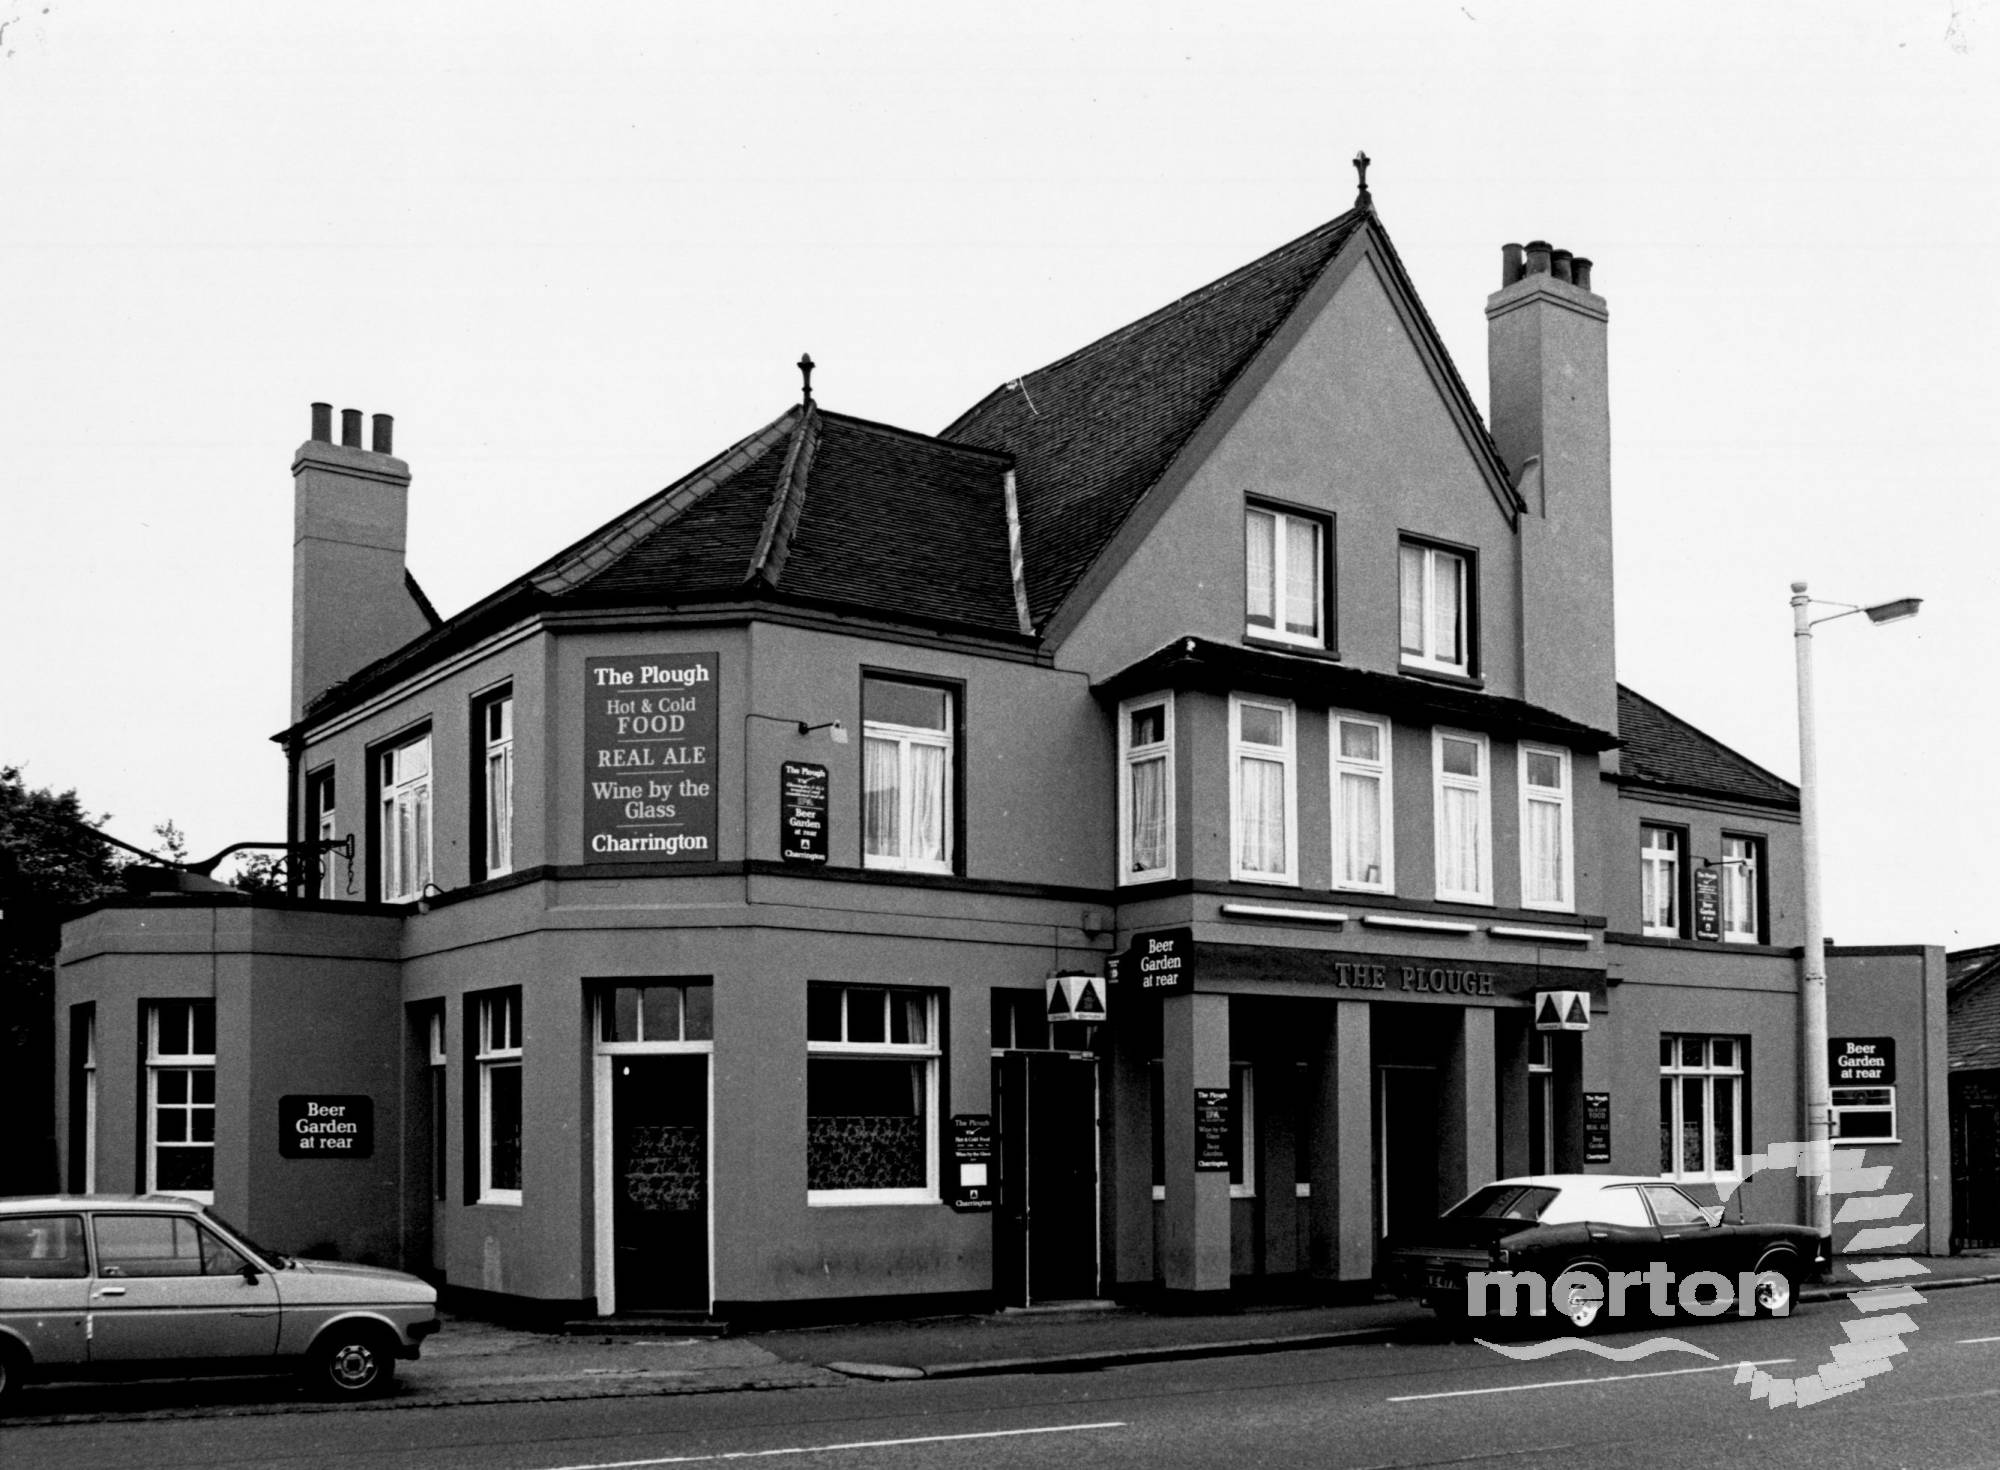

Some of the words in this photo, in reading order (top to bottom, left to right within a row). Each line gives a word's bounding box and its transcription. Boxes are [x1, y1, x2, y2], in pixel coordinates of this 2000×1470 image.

[594, 668, 634, 686] The
[640, 664, 710, 686] Plough
[607, 700, 635, 715] Hot
[641, 700, 653, 713] &
[658, 697, 696, 712] Cold
[617, 715, 685, 734] FOOD
[598, 749, 655, 768] REAL
[663, 746, 706, 765] ALE
[785, 765, 800, 774] The
[801, 767, 826, 778] Plough
[592, 782, 642, 799] Wine
[649, 781, 672, 801] by
[679, 779, 710, 797] the
[625, 801, 676, 819] Glass
[795, 807, 816, 819] Beer
[789, 817, 821, 829] Garden
[803, 829, 817, 837] rear
[592, 833, 708, 855] Charrington
[784, 849, 826, 861] Charrington
[1149, 939, 1174, 954] Beer
[1141, 955, 1182, 972] Garden
[1143, 975, 1153, 988] at
[1155, 973, 1179, 987] rear
[1335, 962, 1386, 989] THE
[1401, 966, 1496, 996] PLOUGH
[1846, 1042, 1876, 1054] Beer
[1838, 1055, 1885, 1067] Garden
[1841, 1068, 1853, 1079] at
[1855, 1069, 1882, 1079] rear
[1197, 1091, 1208, 1099] The
[1209, 1091, 1228, 1099] Plough
[307, 1102, 346, 1117] Beer
[296, 1118, 357, 1134] Garden
[955, 1119, 967, 1127] The
[299, 1136, 315, 1149] at
[320, 1138, 353, 1149] rear
[1198, 1160, 1228, 1168] Charrington
[955, 1199, 992, 1207] Charrington
